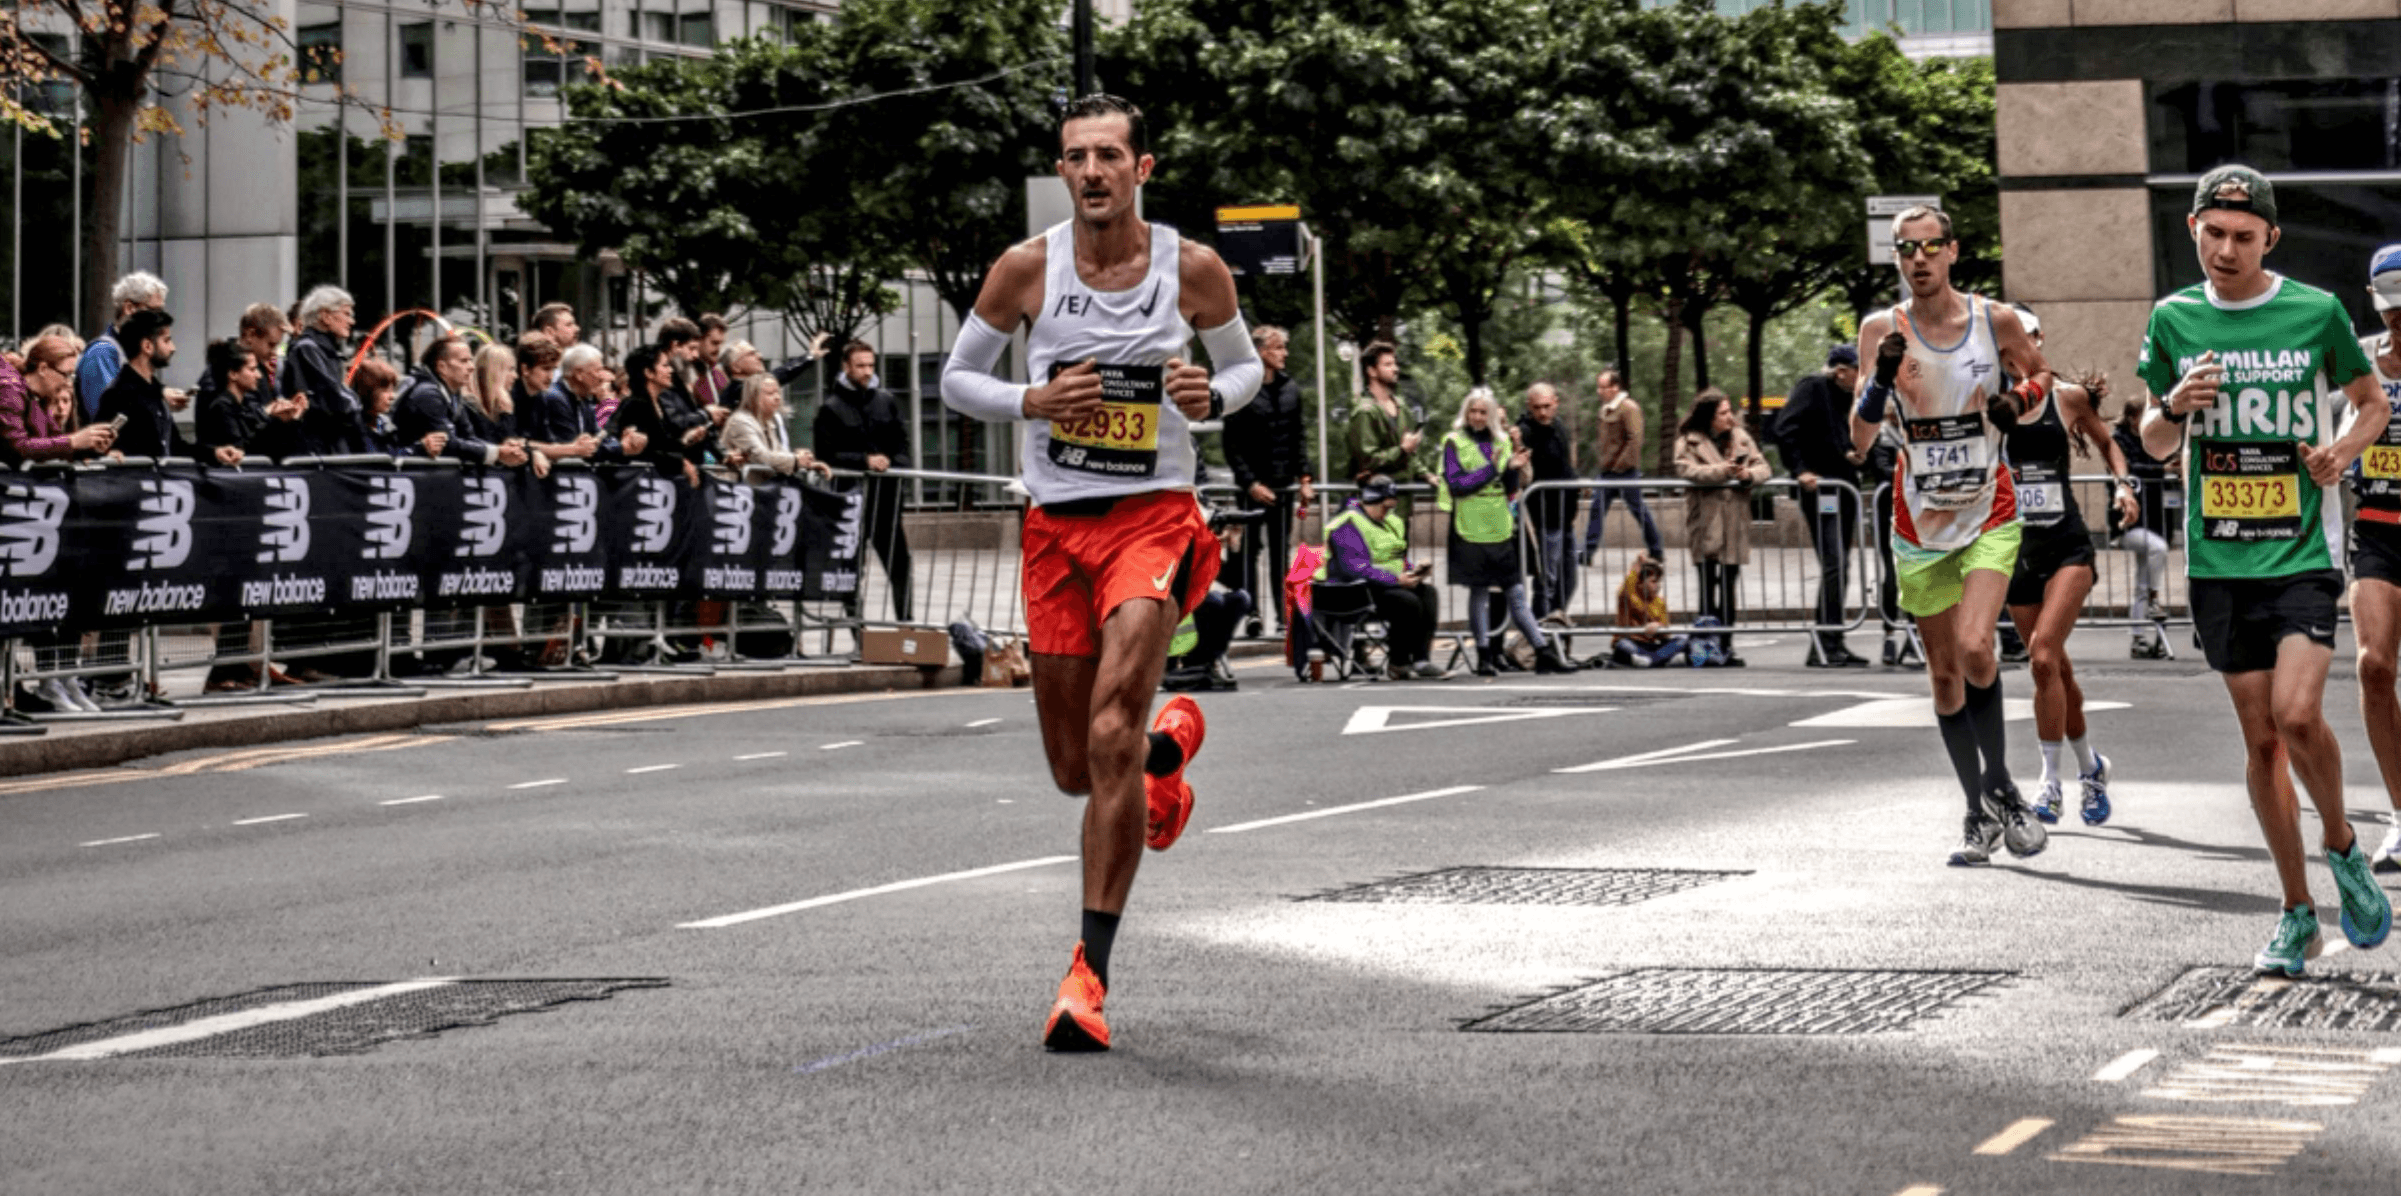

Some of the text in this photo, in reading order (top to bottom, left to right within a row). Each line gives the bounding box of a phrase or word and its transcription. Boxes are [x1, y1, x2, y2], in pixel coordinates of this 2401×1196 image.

[2178, 349, 2312, 376] MMILLAN
[2234, 369, 2304, 383] SUPPORT
[1106, 461, 1148, 473] balance
[1926, 444, 1970, 468] 5741
[2211, 481, 2286, 509] 33373
[241, 572, 326, 607] new balance
[351, 568, 419, 600] new balance
[438, 566, 515, 597] new balance
[541, 563, 605, 592] new balance
[1, 588, 69, 623] balance
[104, 579, 206, 615] new balance
